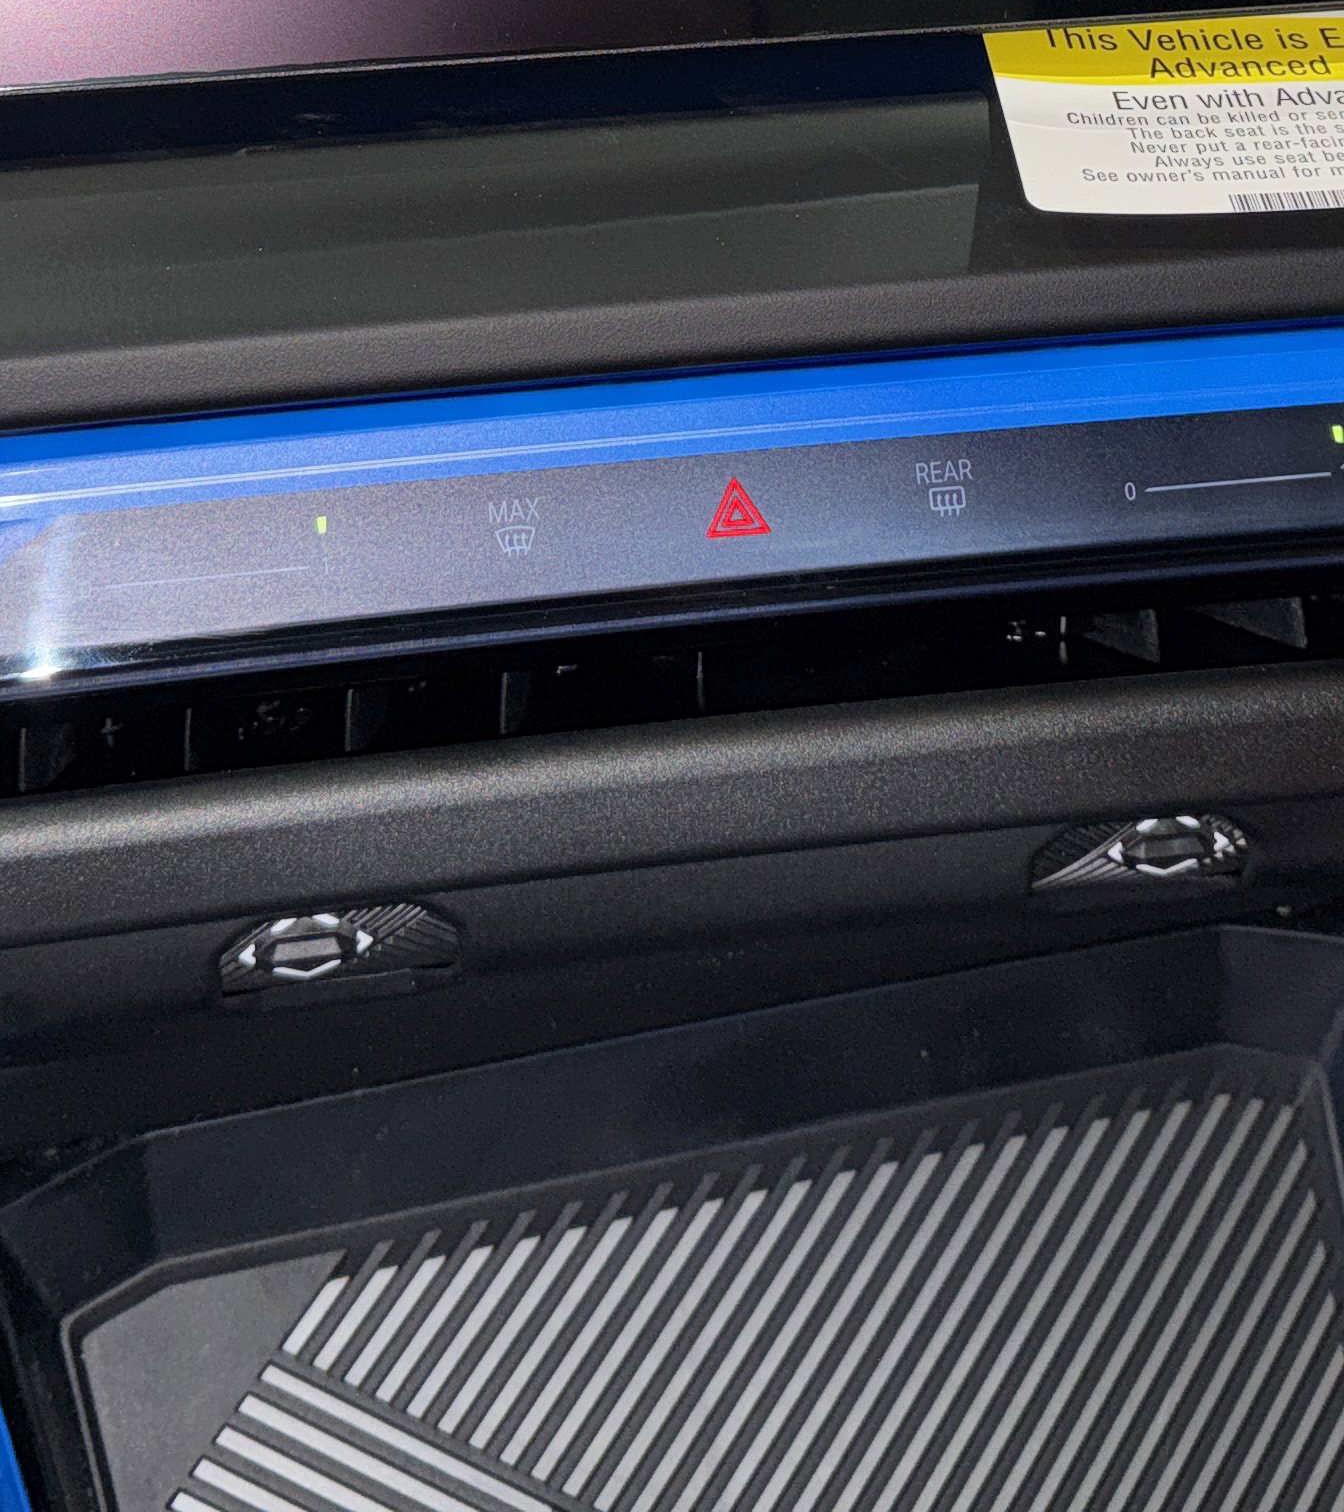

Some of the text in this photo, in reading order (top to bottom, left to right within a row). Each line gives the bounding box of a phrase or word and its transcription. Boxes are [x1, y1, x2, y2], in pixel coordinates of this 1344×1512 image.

[1127, 27, 1264, 51] Vehicle
[1275, 28, 1308, 49] is
[1150, 55, 1331, 78] Advanced
[1112, 91, 1188, 110] Even
[1196, 88, 1264, 108] with
[1066, 112, 1149, 126] Children
[1156, 115, 1190, 126] can
[1197, 113, 1220, 124] be
[1228, 111, 1279, 124] killed
[1288, 111, 1307, 121] or
[1126, 127, 1163, 139] The
[1172, 126, 1217, 139] back
[1225, 126, 1263, 137] seat
[1272, 124, 1289, 135] is
[1295, 123, 1327, 134] the
[1130, 141, 1186, 154] Never
[1197, 141, 1231, 155] put
[1236, 142, 1246, 152] a
[1155, 155, 1224, 169] Always
[1232, 155, 1267, 166] use
[1275, 152, 1315, 164] seat
[1082, 169, 1118, 182] See
[1212, 167, 1285, 180] manual
[1292, 165, 1320, 177] for
[915, 459, 973, 485] REAR
[488, 498, 540, 524] MAX
